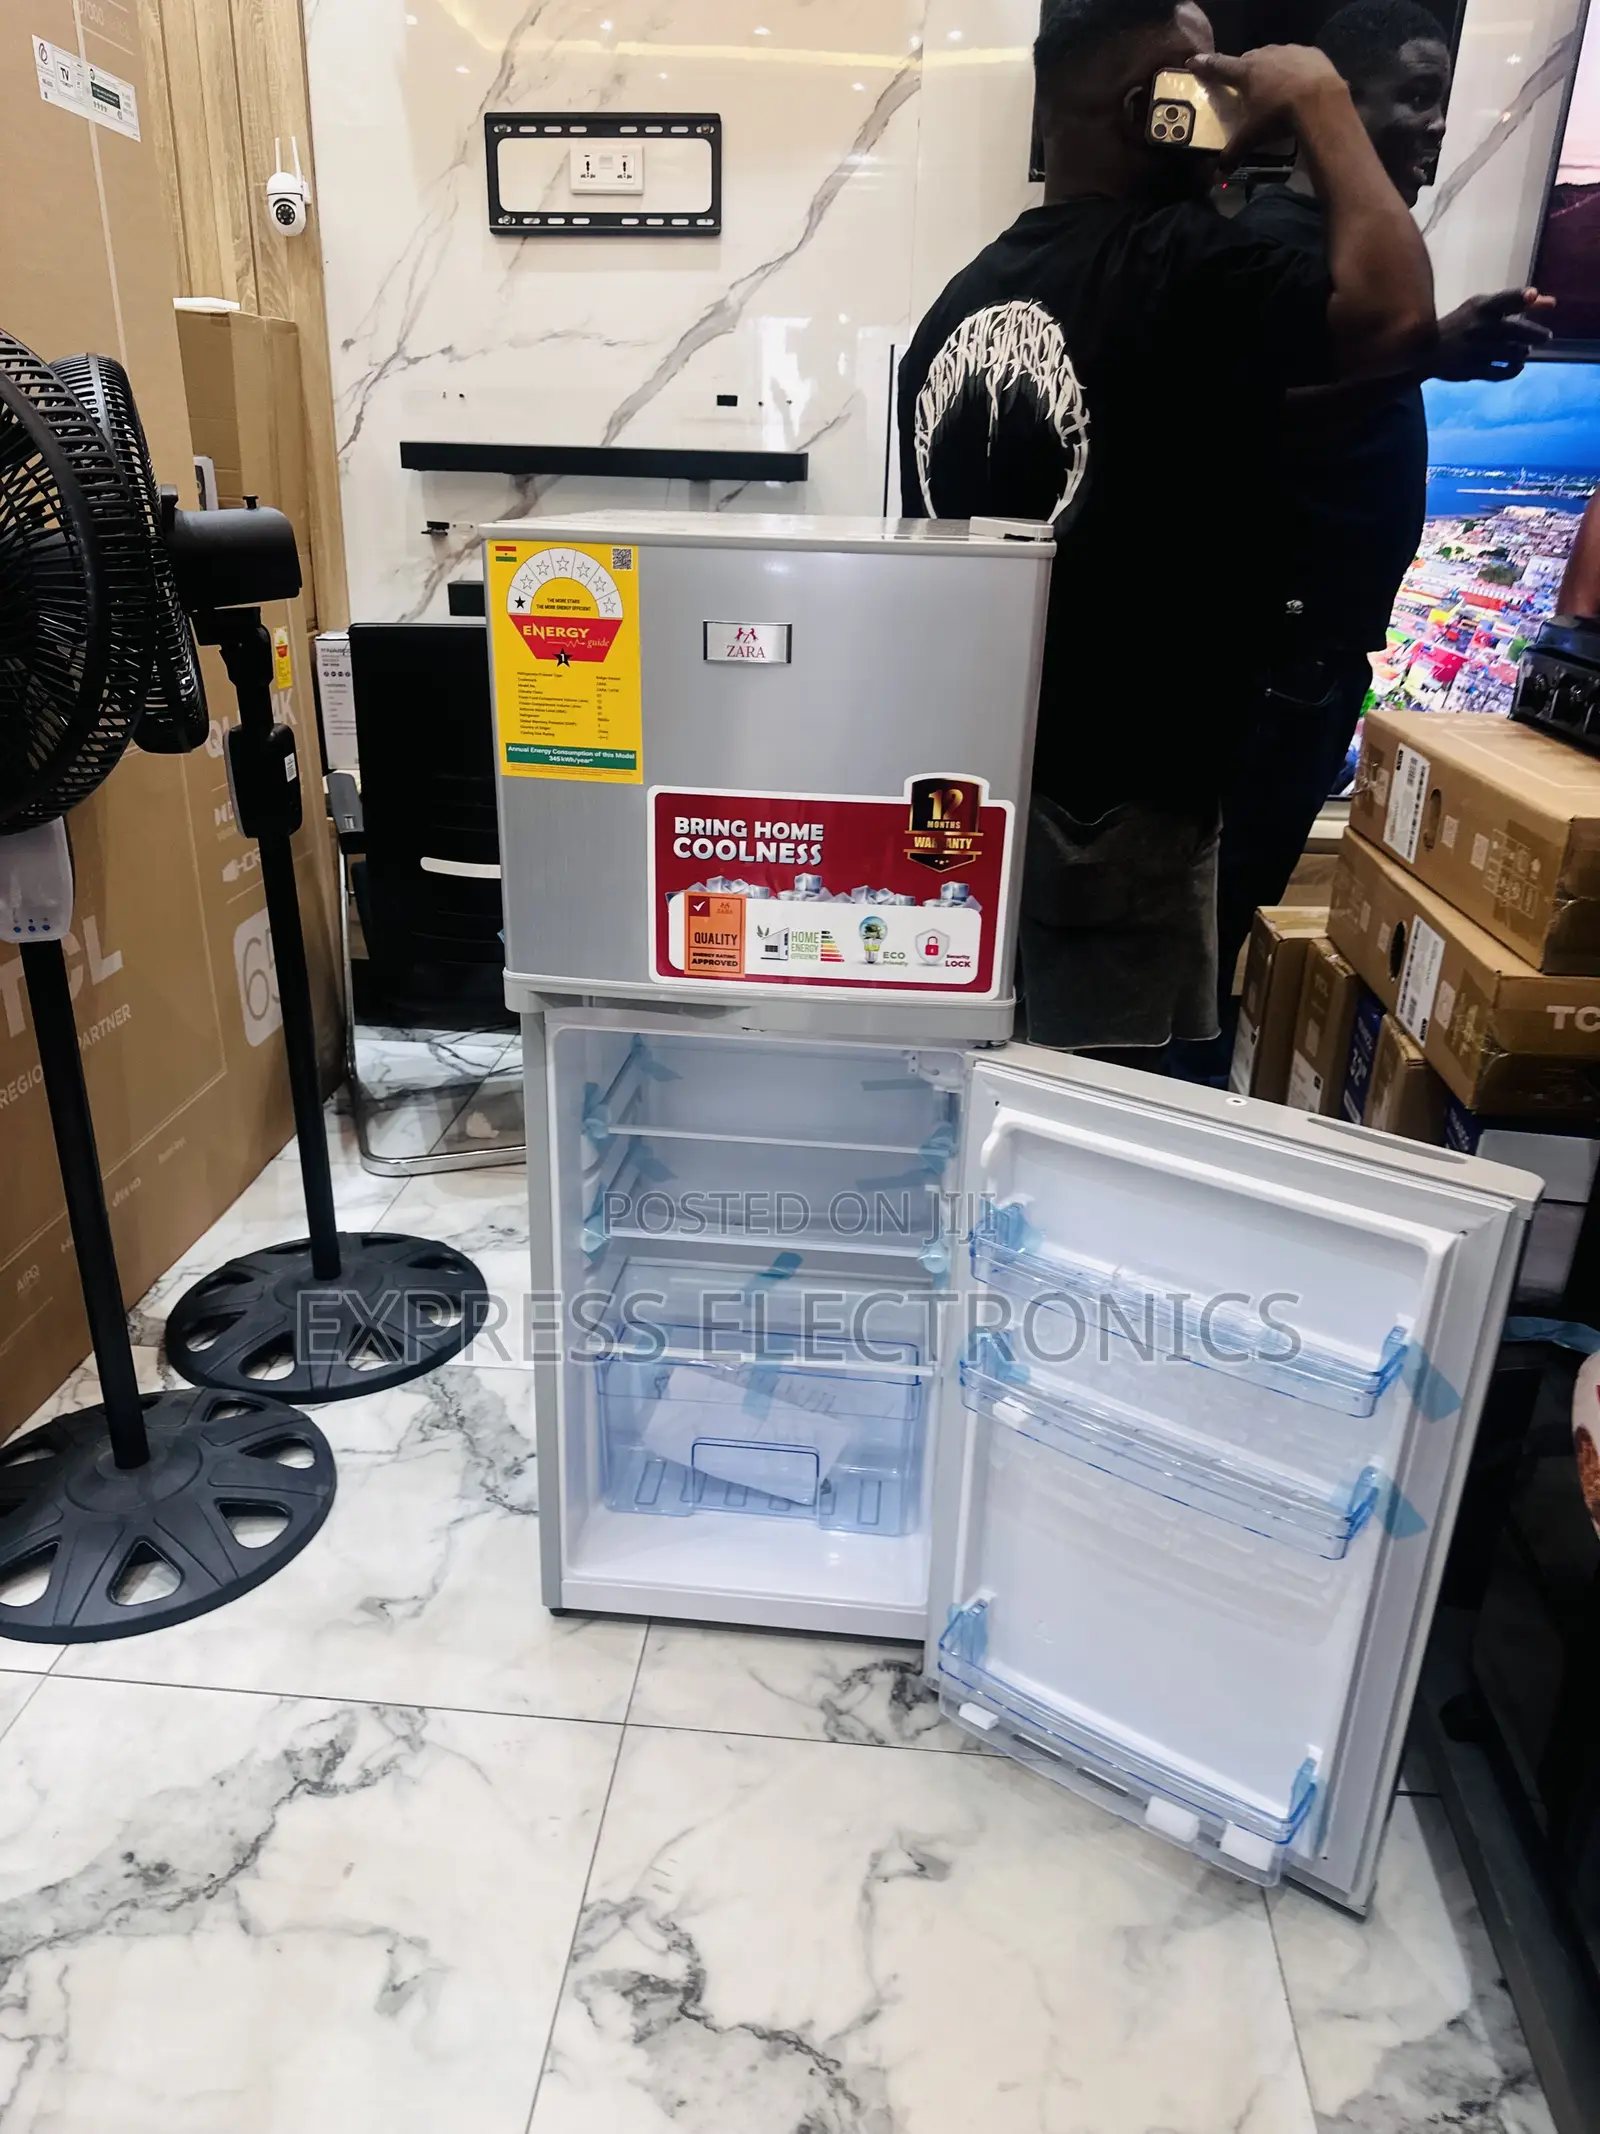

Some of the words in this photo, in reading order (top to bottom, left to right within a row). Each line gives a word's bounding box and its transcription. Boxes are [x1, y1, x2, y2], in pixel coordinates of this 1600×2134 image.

[522, 622, 590, 640] ENERGY
[587, 638, 610, 648] guide
[726, 645, 766, 658] ZARA
[560, 654, 565, 662] 1
[530, 747, 551, 755] Energy
[552, 748, 593, 757] Consumption
[928, 788, 964, 820] 12
[674, 816, 748, 838] BRING
[754, 820, 824, 842] HOME
[927, 820, 961, 829] MONTHS
[914, 836, 972, 849] WAANTY
[673, 836, 823, 866] COOLNESS
[694, 932, 738, 946] QUALITY
[791, 931, 819, 943] HOME
[791, 943, 819, 953] ENERGY
[883, 952, 906, 960] ECO
[692, 958, 738, 967] APPROVED
[0, 1064, 44, 1109] REGIO
